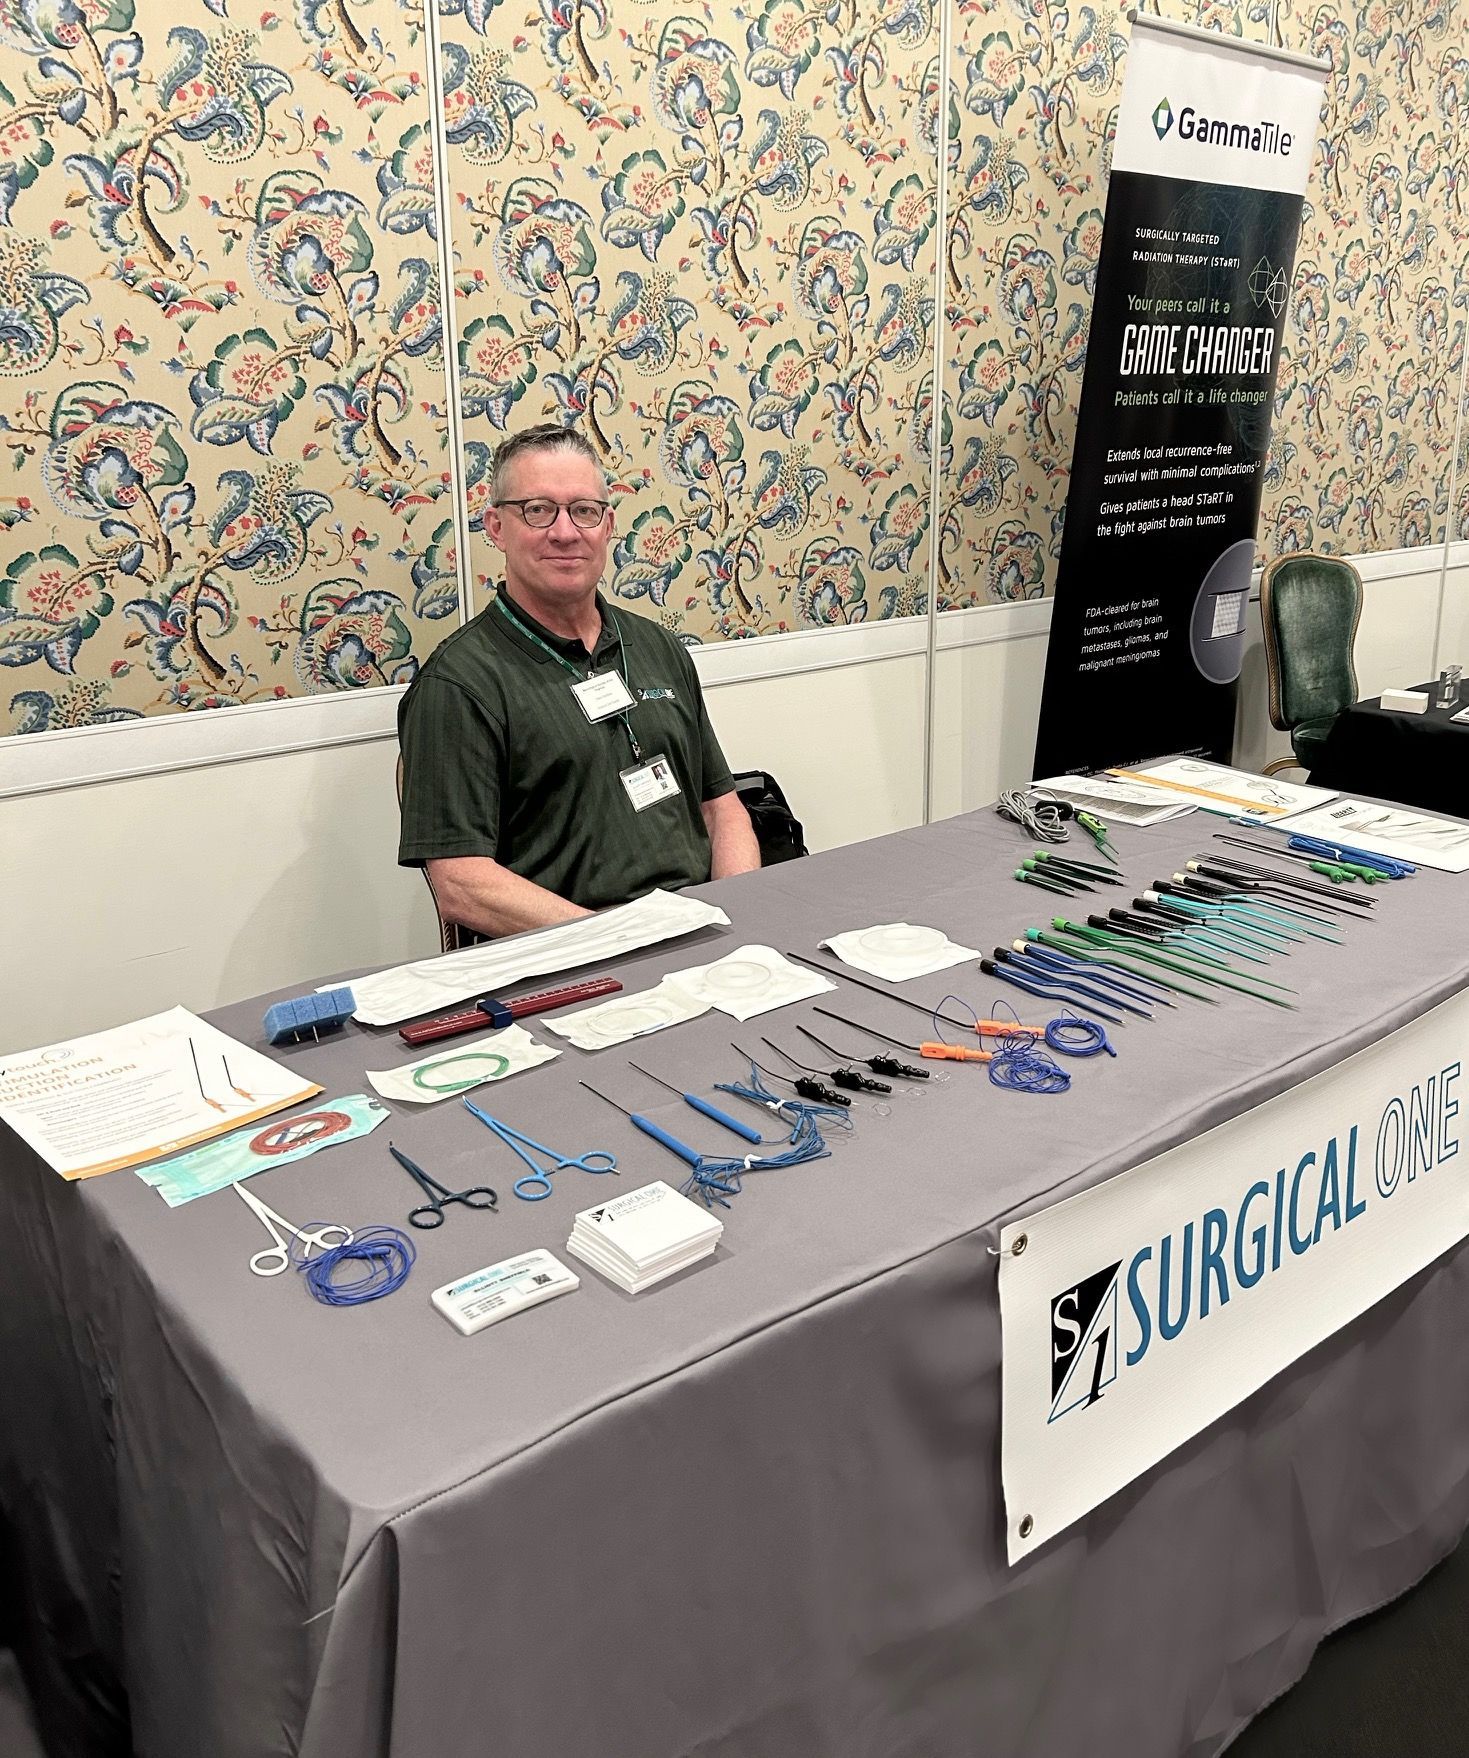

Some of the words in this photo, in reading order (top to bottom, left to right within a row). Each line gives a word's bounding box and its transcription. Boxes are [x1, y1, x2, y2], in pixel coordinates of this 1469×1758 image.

[1178, 107, 1292, 156] GammaTile
[1135, 227, 1180, 242] SURGICALLY
[1182, 231, 1220, 245] TARGETED
[1132, 250, 1173, 263] RADIATION
[1175, 253, 1208, 266] THERAPY
[1211, 256, 1240, 269] (STaRT)
[1127, 294, 1152, 311] Your
[1155, 298, 1183, 315] peers
[1187, 297, 1205, 313] call
[1210, 299, 1219, 314] it
[1223, 301, 1231, 314] a
[1119, 323, 1181, 376] GAME
[1182, 325, 1275, 375] CHANGER
[1114, 390, 1158, 406] Patients
[1162, 389, 1180, 404] call
[1184, 389, 1193, 404] it
[1197, 391, 1204, 403] a
[1208, 388, 1227, 404] life
[1230, 388, 1268, 406] changer
[1107, 448, 1141, 463] Extends
[1143, 445, 1163, 460] local
[1165, 442, 1233, 458] recurrence-free
[1103, 469, 1137, 485] survival
[1140, 468, 1159, 482] with
[1161, 465, 1198, 480] minimal
[1100, 502, 1123, 515] Gives
[1126, 498, 1160, 515] patients
[1161, 497, 1168, 508] a
[1170, 494, 1194, 508] head
[1196, 491, 1224, 506] STaRT
[1225, 491, 1234, 503] in
[1096, 524, 1112, 537] the
[1114, 522, 1136, 537] fight
[1137, 517, 1167, 534] against
[1169, 514, 1193, 528] brain
[1196, 512, 1226, 526] tumors
[1085, 603, 1130, 618] FDA-cleared
[1130, 602, 1141, 612] for
[1141, 597, 1159, 609] brain
[1083, 624, 1112, 637] tumors,
[1113, 618, 1142, 633] including
[1144, 613, 1163, 625] brain
[1080, 640, 1123, 655] metastases,
[1124, 633, 1152, 648] gliomas,
[1154, 629, 1169, 640] and
[1078, 657, 1114, 672] malignant
[1115, 648, 1160, 665] meningiomas
[1126, 1124, 1367, 1367] SURGICAL
[1375, 1062, 1461, 1198] ONE
